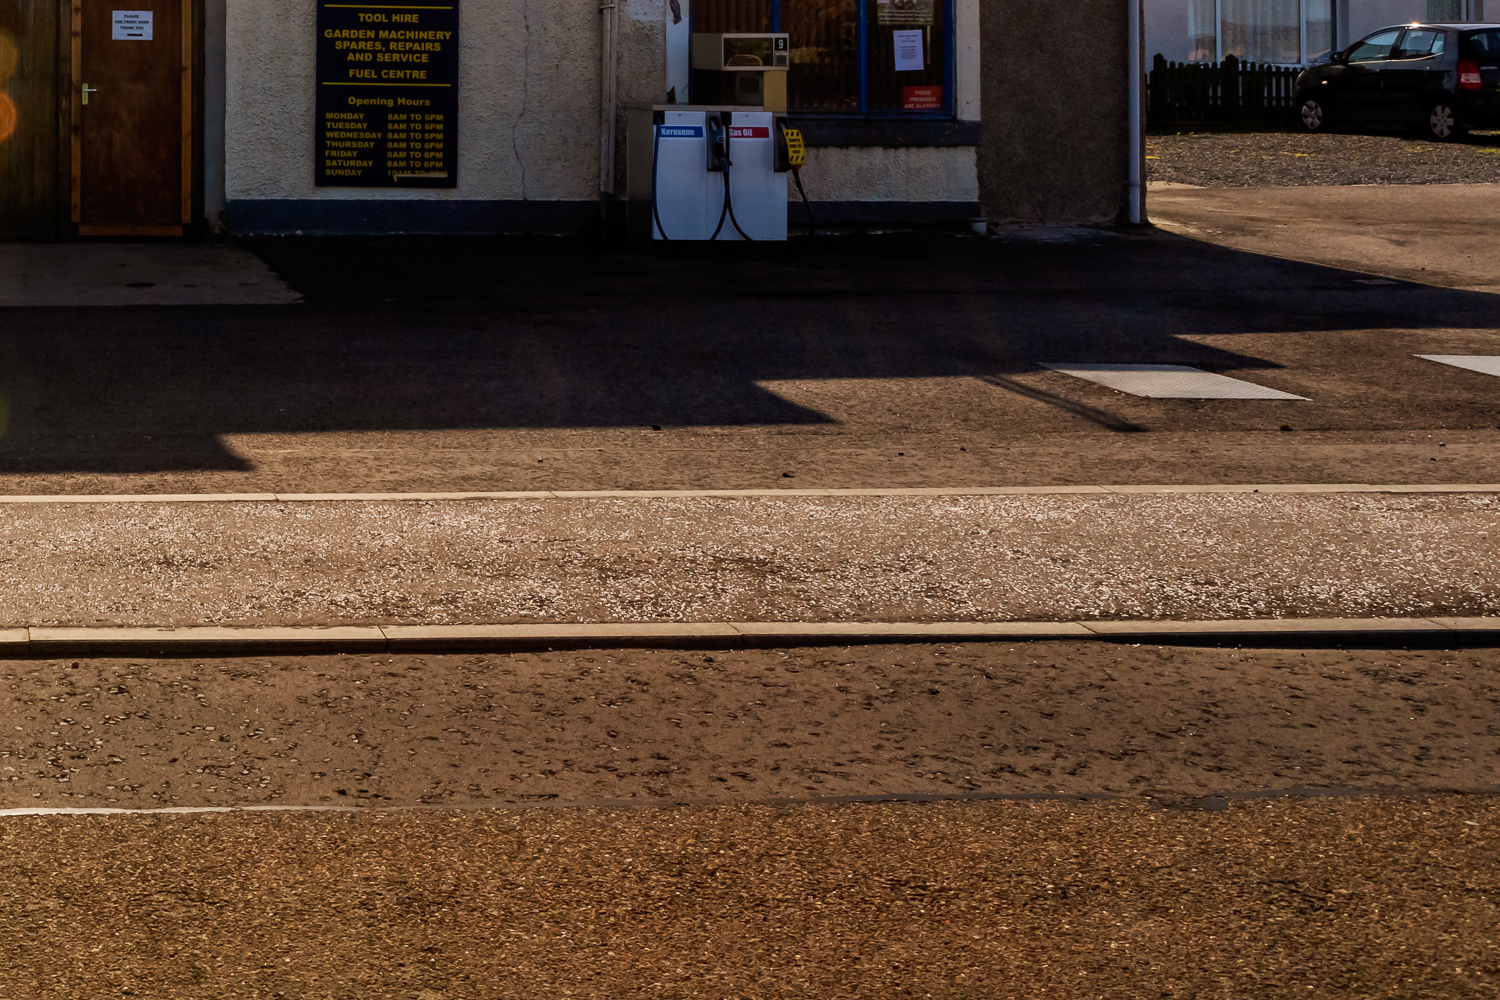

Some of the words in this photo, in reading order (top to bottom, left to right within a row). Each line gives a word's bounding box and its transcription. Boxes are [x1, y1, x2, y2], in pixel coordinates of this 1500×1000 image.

[359, 14, 388, 22] TOOL
[392, 14, 418, 22] HIRE
[325, 29, 375, 38] GARDEN
[379, 30, 451, 39] MACHINERY
[336, 41, 385, 51] SPARES,
[390, 42, 441, 51] REPAIRS
[778, 39, 784, 49] 9
[347, 53, 372, 61] AND
[377, 53, 428, 62] SERVICE
[349, 69, 377, 78] FUEL
[382, 70, 426, 78] CENTRE
[348, 97, 393, 107] Opening
[398, 97, 431, 106] Hours
[325, 112, 365, 120] MONDAY
[388, 113, 407, 121] 8AM
[410, 113, 422, 121] TO
[425, 113, 444, 121] 6PM
[326, 121, 368, 130] TUESDAY
[388, 122, 407, 130] 8AM
[325, 131, 382, 139] WEDNESDAY
[410, 132, 422, 140] TO
[425, 132, 444, 140] 6PM
[325, 140, 375, 148] THURSDAY
[388, 141, 407, 149] 8AM
[410, 141, 422, 149] TO
[424, 142, 444, 150] 6PM
[325, 150, 358, 158] FRIDAY
[410, 151, 422, 159] TO
[424, 151, 444, 159] 6PM
[325, 159, 374, 167] SATURDAY
[387, 160, 407, 168] 8AM
[410, 160, 422, 168] TO
[424, 160, 443, 168] 6PM
[325, 168, 363, 176] SUNDAY
